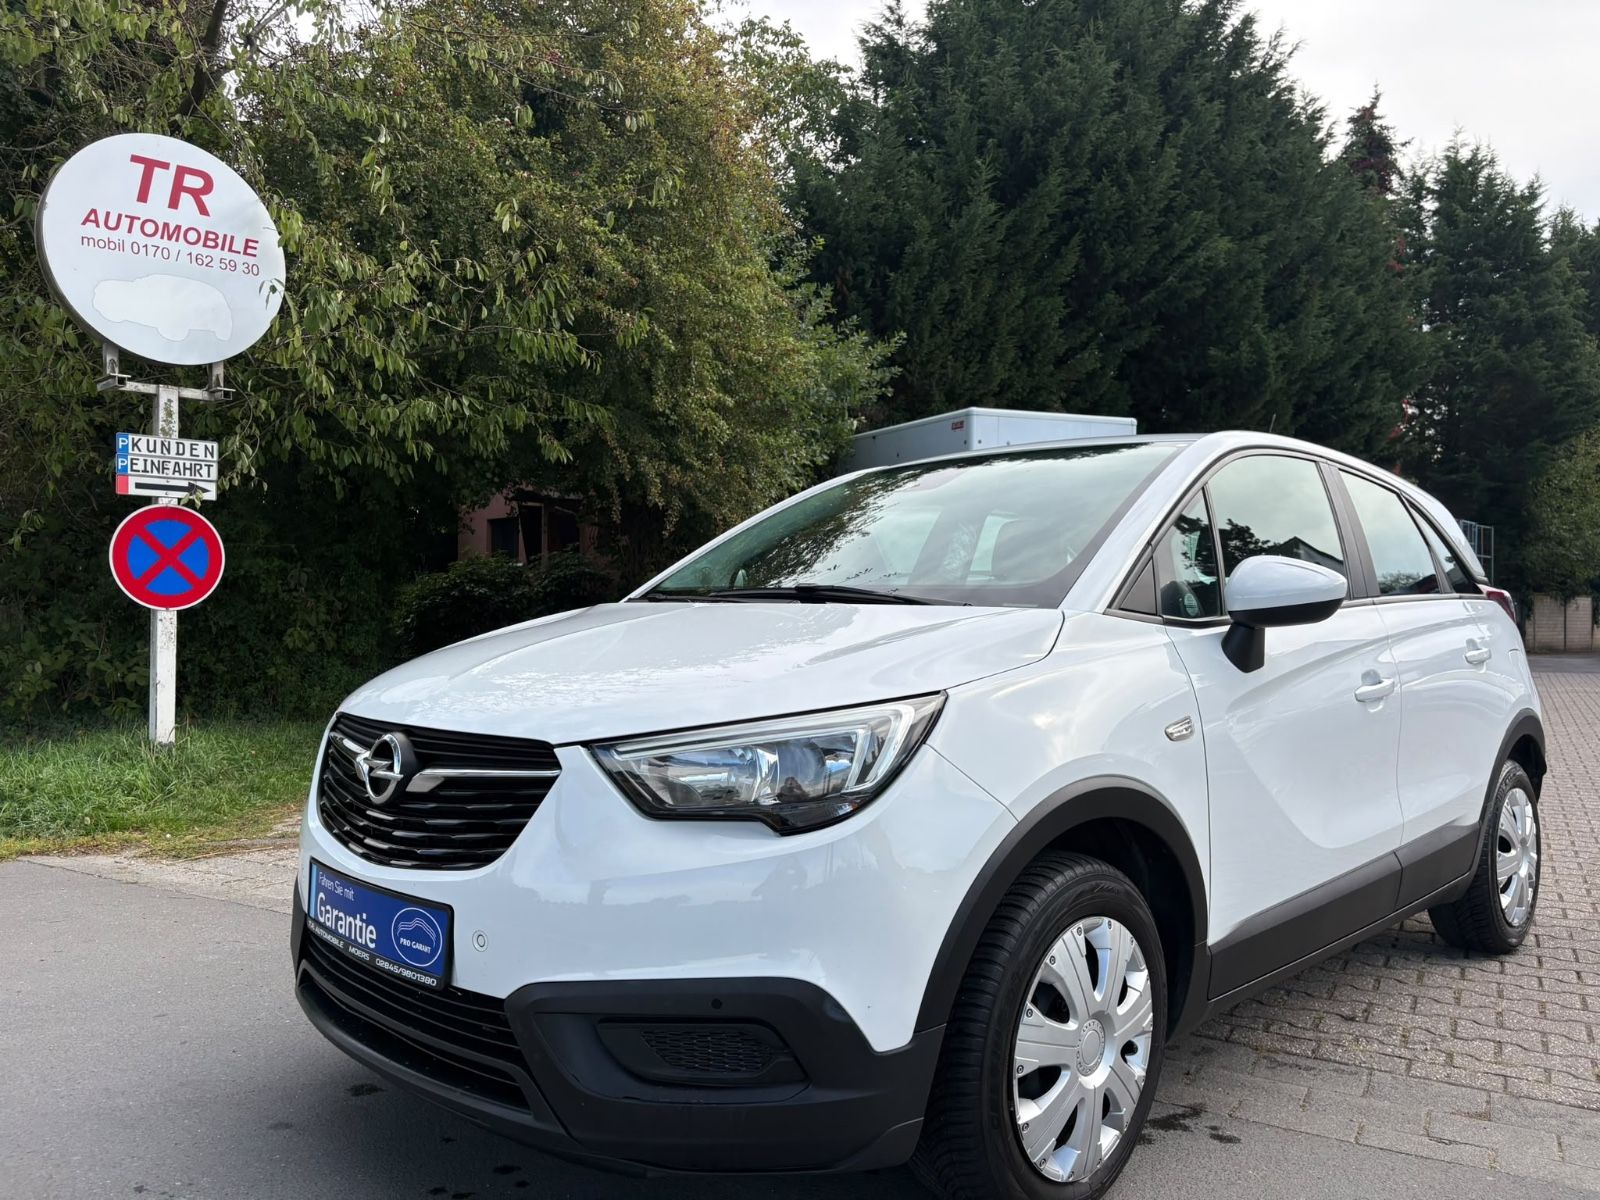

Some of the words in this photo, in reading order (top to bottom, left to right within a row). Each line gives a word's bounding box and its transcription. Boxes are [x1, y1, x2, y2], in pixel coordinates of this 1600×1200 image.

[130, 154, 214, 217] TR
[81, 208, 259, 258] AUTOMOBILE
[81, 235, 125, 254] mobil
[131, 241, 171, 260] 0170
[175, 249, 181, 262] /
[187, 252, 214, 268] 162
[219, 257, 237, 272] 59
[242, 262, 260, 277] 30
[118, 438, 128, 449] P
[131, 438, 214, 458] KUNDEN
[118, 458, 128, 470] P
[130, 457, 214, 478] EINFAHRT
[319, 872, 334, 892] Fahren
[334, 880, 343, 896] Sie
[343, 886, 354, 901] mit
[317, 892, 377, 949] Garantie
[315, 926, 344, 949] AUTOMOBILE
[348, 945, 370, 960] MOERS
[375, 958, 437, 986] 02845/9801380
[400, 937, 411, 947] PRO
